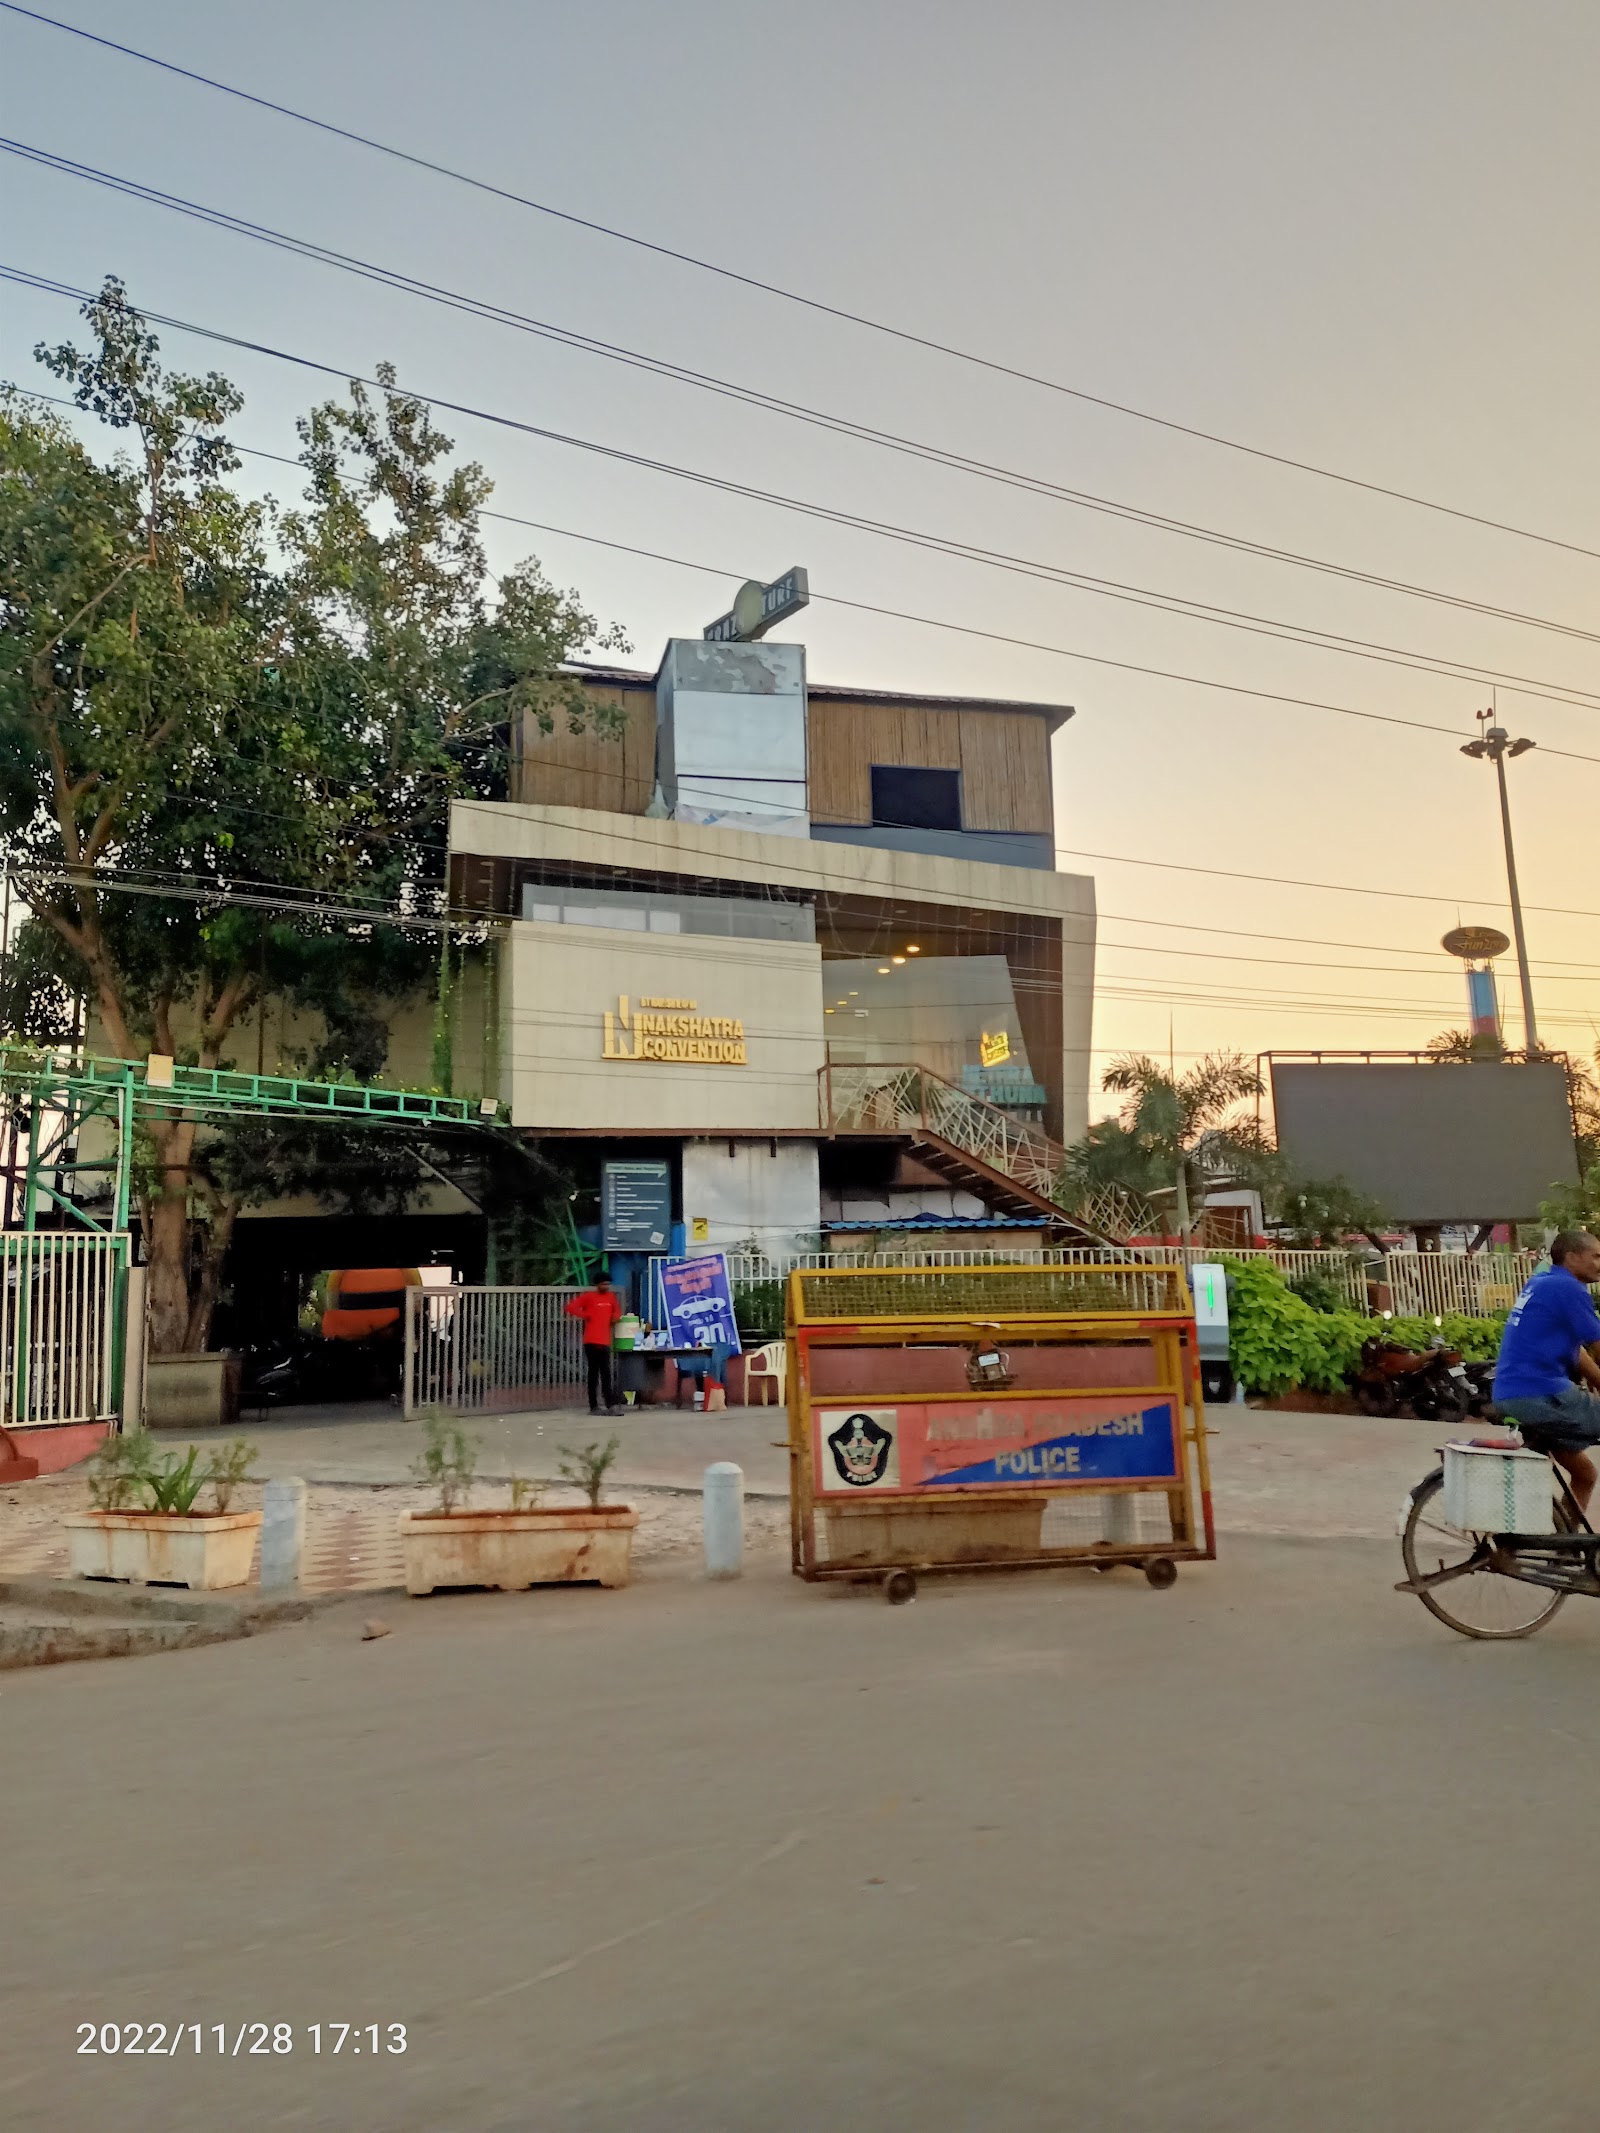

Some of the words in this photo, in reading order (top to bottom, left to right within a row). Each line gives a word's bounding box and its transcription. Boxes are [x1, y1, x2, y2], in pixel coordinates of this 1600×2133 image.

[762, 577, 793, 616] TURF
[643, 1014, 745, 1040] NAKSHATRA
[643, 1037, 746, 1062] CONVENTION
[995, 1446, 1081, 1475] POLICE
